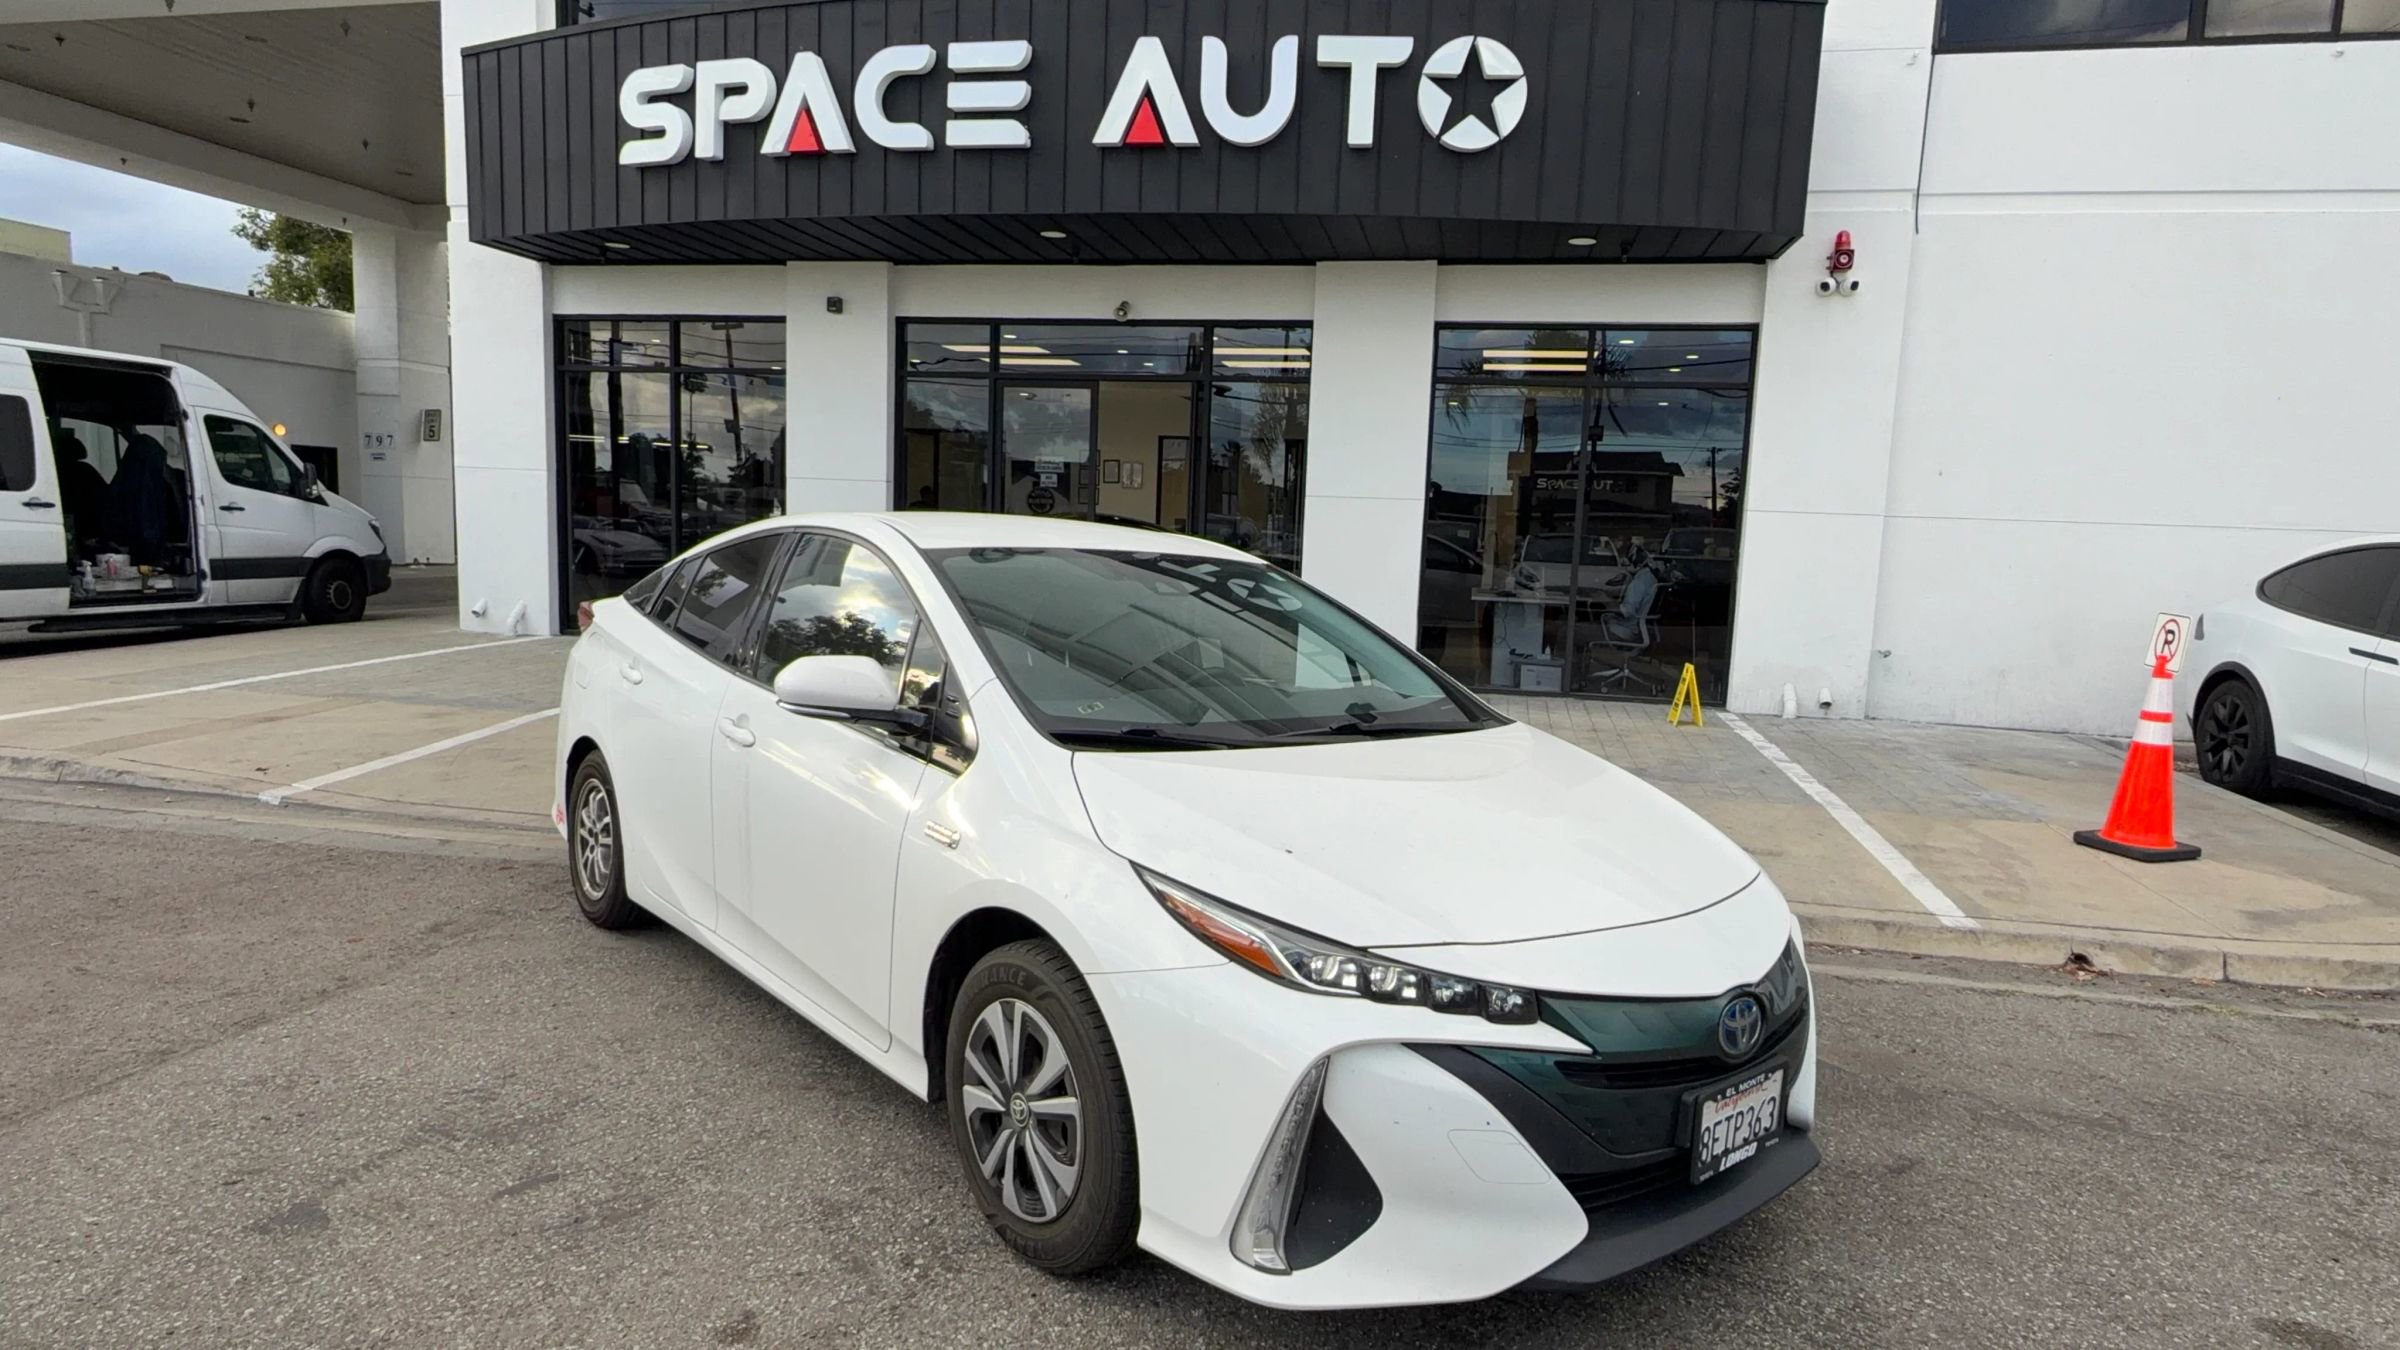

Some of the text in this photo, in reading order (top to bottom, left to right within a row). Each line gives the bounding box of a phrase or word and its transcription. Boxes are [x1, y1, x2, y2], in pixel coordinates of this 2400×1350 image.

[619, 34, 1528, 168] SPACE AUTO
[428, 425, 436, 439] 5
[364, 435, 393, 446] 797
